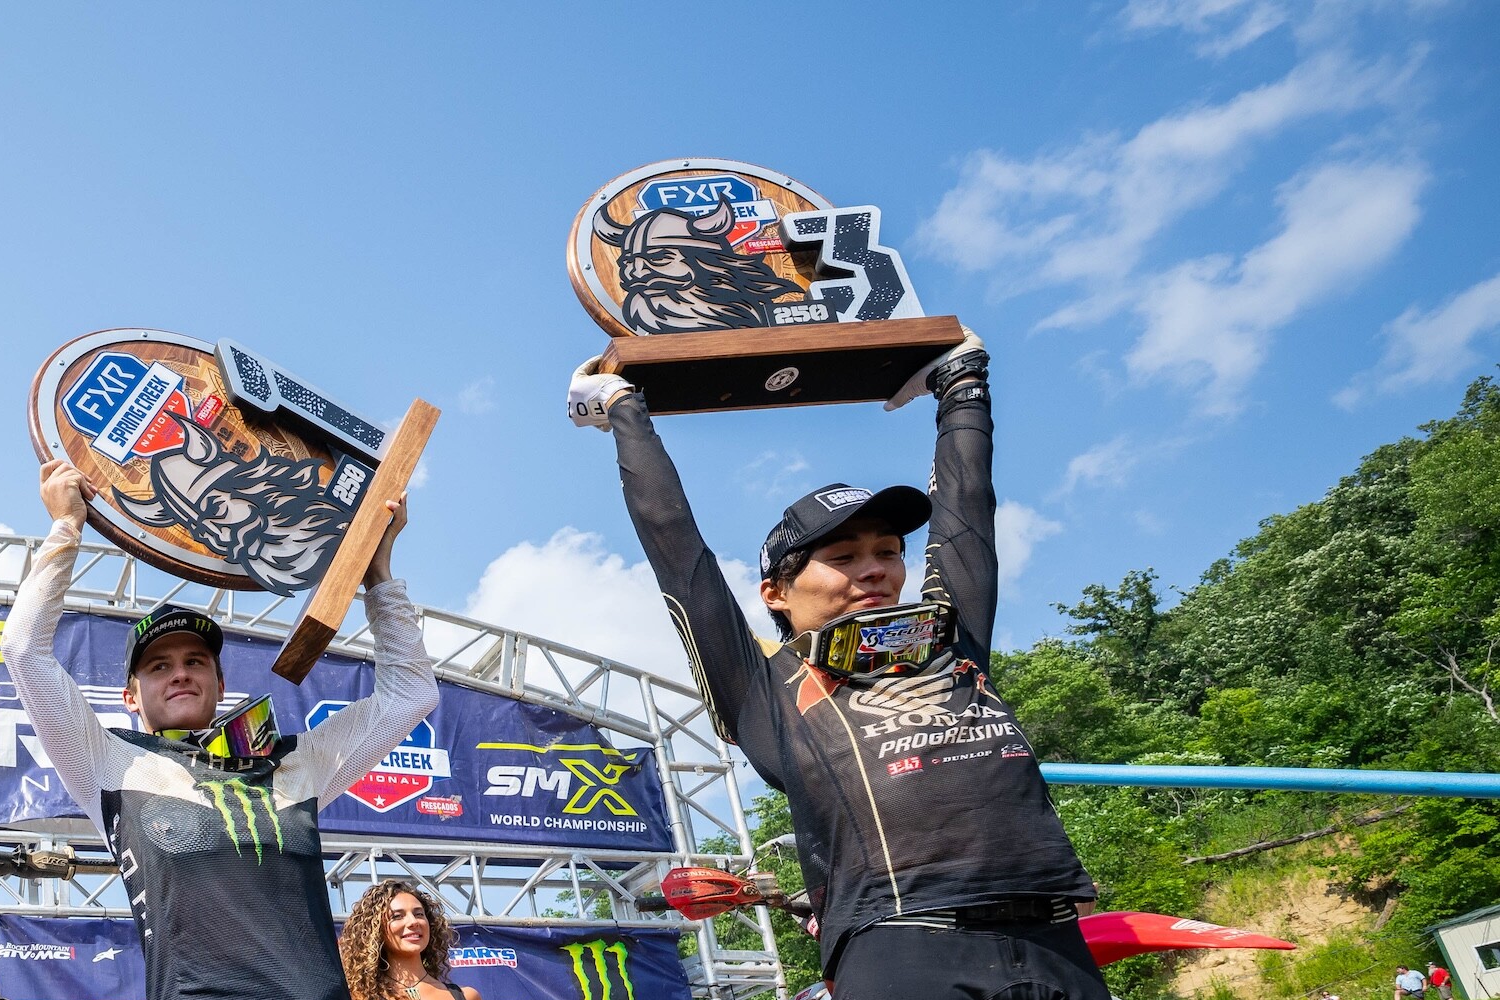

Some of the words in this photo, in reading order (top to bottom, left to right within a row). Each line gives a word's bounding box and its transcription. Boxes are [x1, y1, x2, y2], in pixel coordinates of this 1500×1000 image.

[658, 181, 736, 206] FXR
[782, 206, 924, 322] 3
[773, 303, 829, 324] 250
[75, 361, 136, 422] FXR
[107, 405, 146, 449] SPRING
[136, 374, 170, 412] CREEK
[331, 462, 367, 507] 250
[148, 616, 189, 637] YAMAHA
[860, 703, 1008, 739] HONDA
[879, 721, 1015, 759] PROGRESSIVE
[942, 750, 993, 763] DUNLOP
[484, 758, 638, 816] SMX
[420, 801, 459, 812] FRESCADOS
[490, 813, 541, 828] WORLD
[543, 817, 647, 833] CHAMPIONSHIP
[35, 855, 69, 867] ARC
[673, 870, 713, 880] HONDA
[6, 942, 29, 951] ROCKY
[30, 943, 71, 952] MOUNTAIN
[449, 947, 516, 960] PARTS
